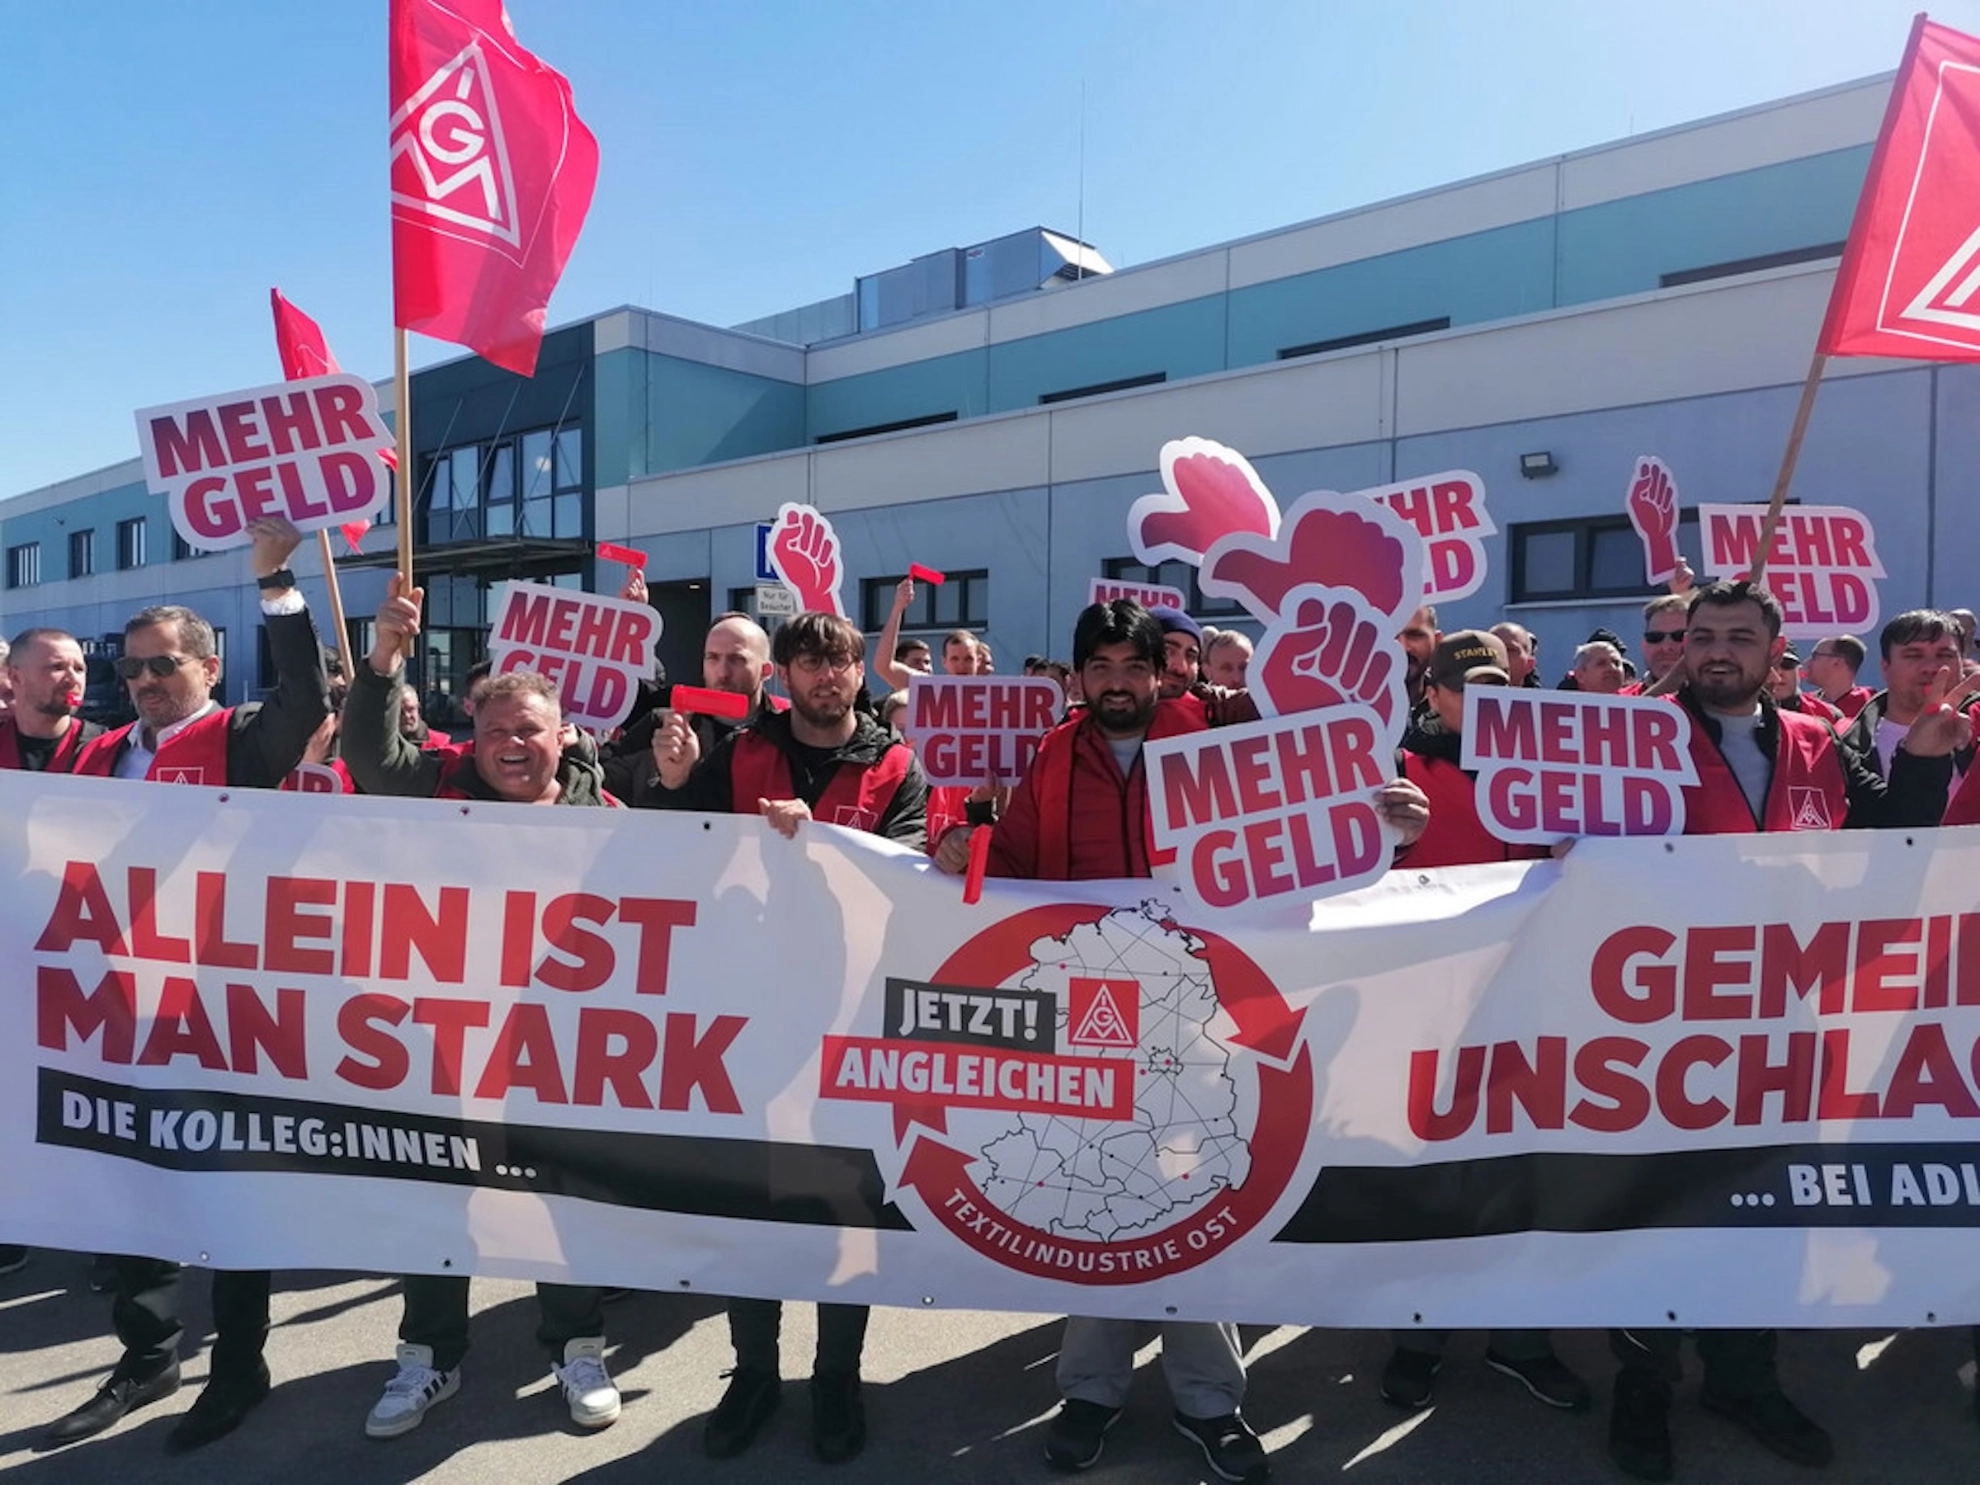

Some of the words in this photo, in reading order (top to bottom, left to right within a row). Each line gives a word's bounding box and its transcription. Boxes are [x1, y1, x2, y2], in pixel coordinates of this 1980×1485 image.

[150, 385, 376, 478] MEHR
[183, 452, 376, 538] GELD
[1373, 481, 1480, 537] HR
[1710, 514, 1872, 567] MEHR
[499, 591, 652, 666] MEHR
[1732, 571, 1869, 623] ELD
[915, 684, 1055, 729] MEHR
[1475, 698, 1682, 771] MEHR
[1160, 717, 1384, 830] MEHR
[1489, 767, 1672, 835] GELD
[1191, 802, 1382, 908] GELD
[35, 861, 470, 983] ALLEIN
[501, 890, 697, 995] IST
[1591, 912, 1980, 1024] GEMEI
[37, 966, 308, 1080] MAN
[335, 993, 749, 1114] STARK
[899, 988, 1038, 1041] JETZT!
[835, 1047, 1115, 1108] ANGLEICHEN
[1408, 1023, 1980, 1141] UNSCHLA
[63, 1090, 136, 1141] DIE
[150, 1110, 481, 1171] KOLLEG:INNEN
[1788, 1164, 1872, 1206] BEI
[944, 1188, 1181, 1273] TEXTILINDUSTRIE
[1187, 1206, 1237, 1250] OST
